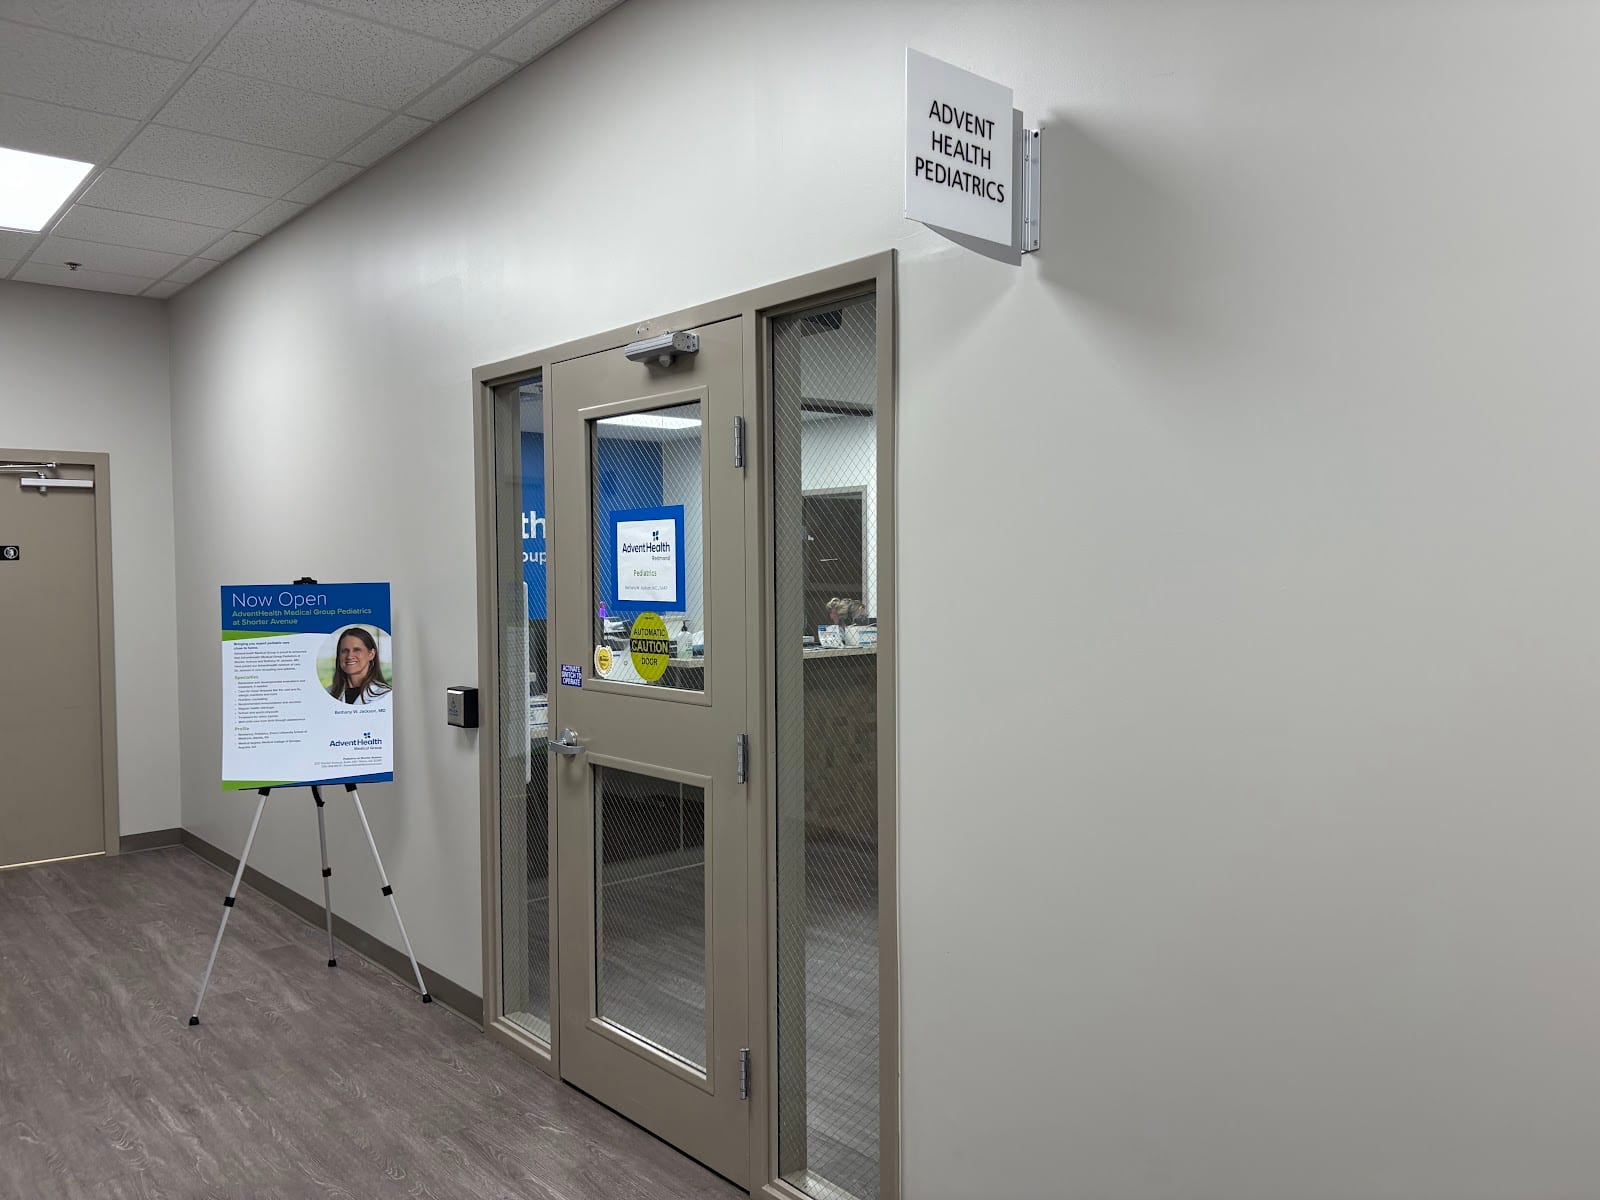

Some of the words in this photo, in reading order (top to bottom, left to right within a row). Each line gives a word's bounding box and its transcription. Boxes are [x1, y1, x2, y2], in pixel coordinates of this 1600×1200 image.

[929, 100, 995, 140] ADVENT
[932, 131, 991, 170] HEALTH
[915, 156, 1005, 203] PEDIATRICS
[633, 569, 657, 577] Pediatrics
[232, 592, 273, 608] Now
[278, 591, 327, 609] Open
[232, 610, 282, 618] AdventHealth
[241, 618, 269, 626] Shorter
[634, 628, 665, 637] AUTOMATIC
[631, 640, 668, 654] CAUTION
[641, 657, 658, 666] DOOR
[562, 677, 581, 686] OPERATE
[329, 738, 383, 747] AdventHealth
